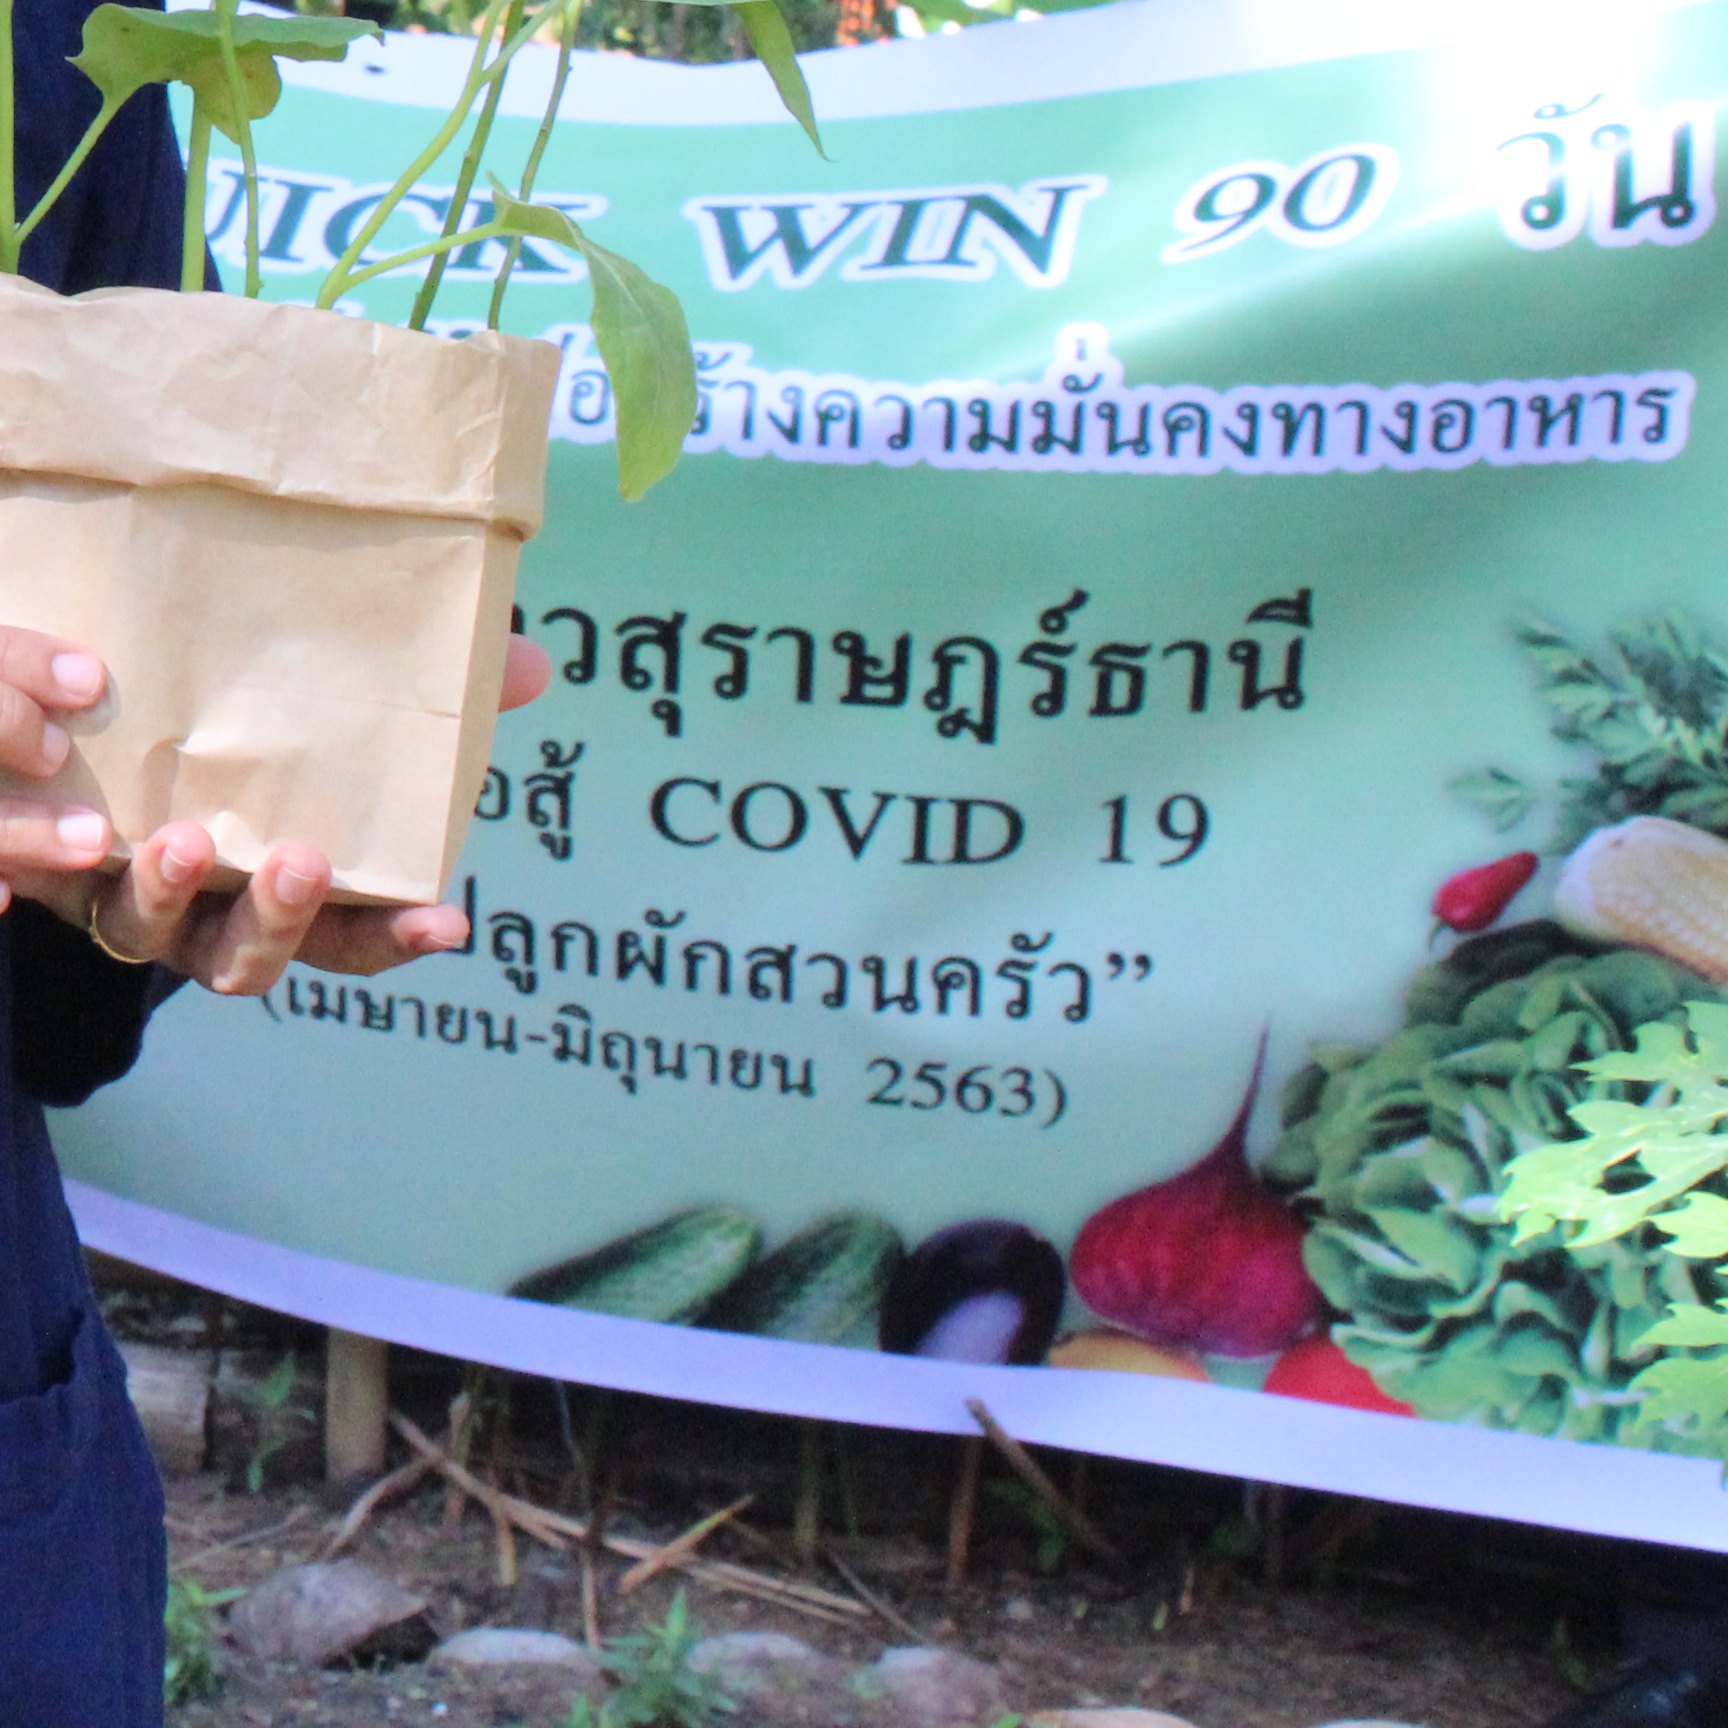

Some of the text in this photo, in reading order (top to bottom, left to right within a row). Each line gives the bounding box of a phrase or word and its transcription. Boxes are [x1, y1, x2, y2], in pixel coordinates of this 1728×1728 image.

[700, 183, 1090, 280] WIN
[1163, 152, 1378, 256] 90
[1495, 92, 1697, 230] วัน
[511, 586, 1317, 745] วสุราษฎร์ธานี
[648, 775, 1028, 869] COVID
[1098, 792, 1212, 869] 19
[864, 1055, 1070, 1130] 2563)
